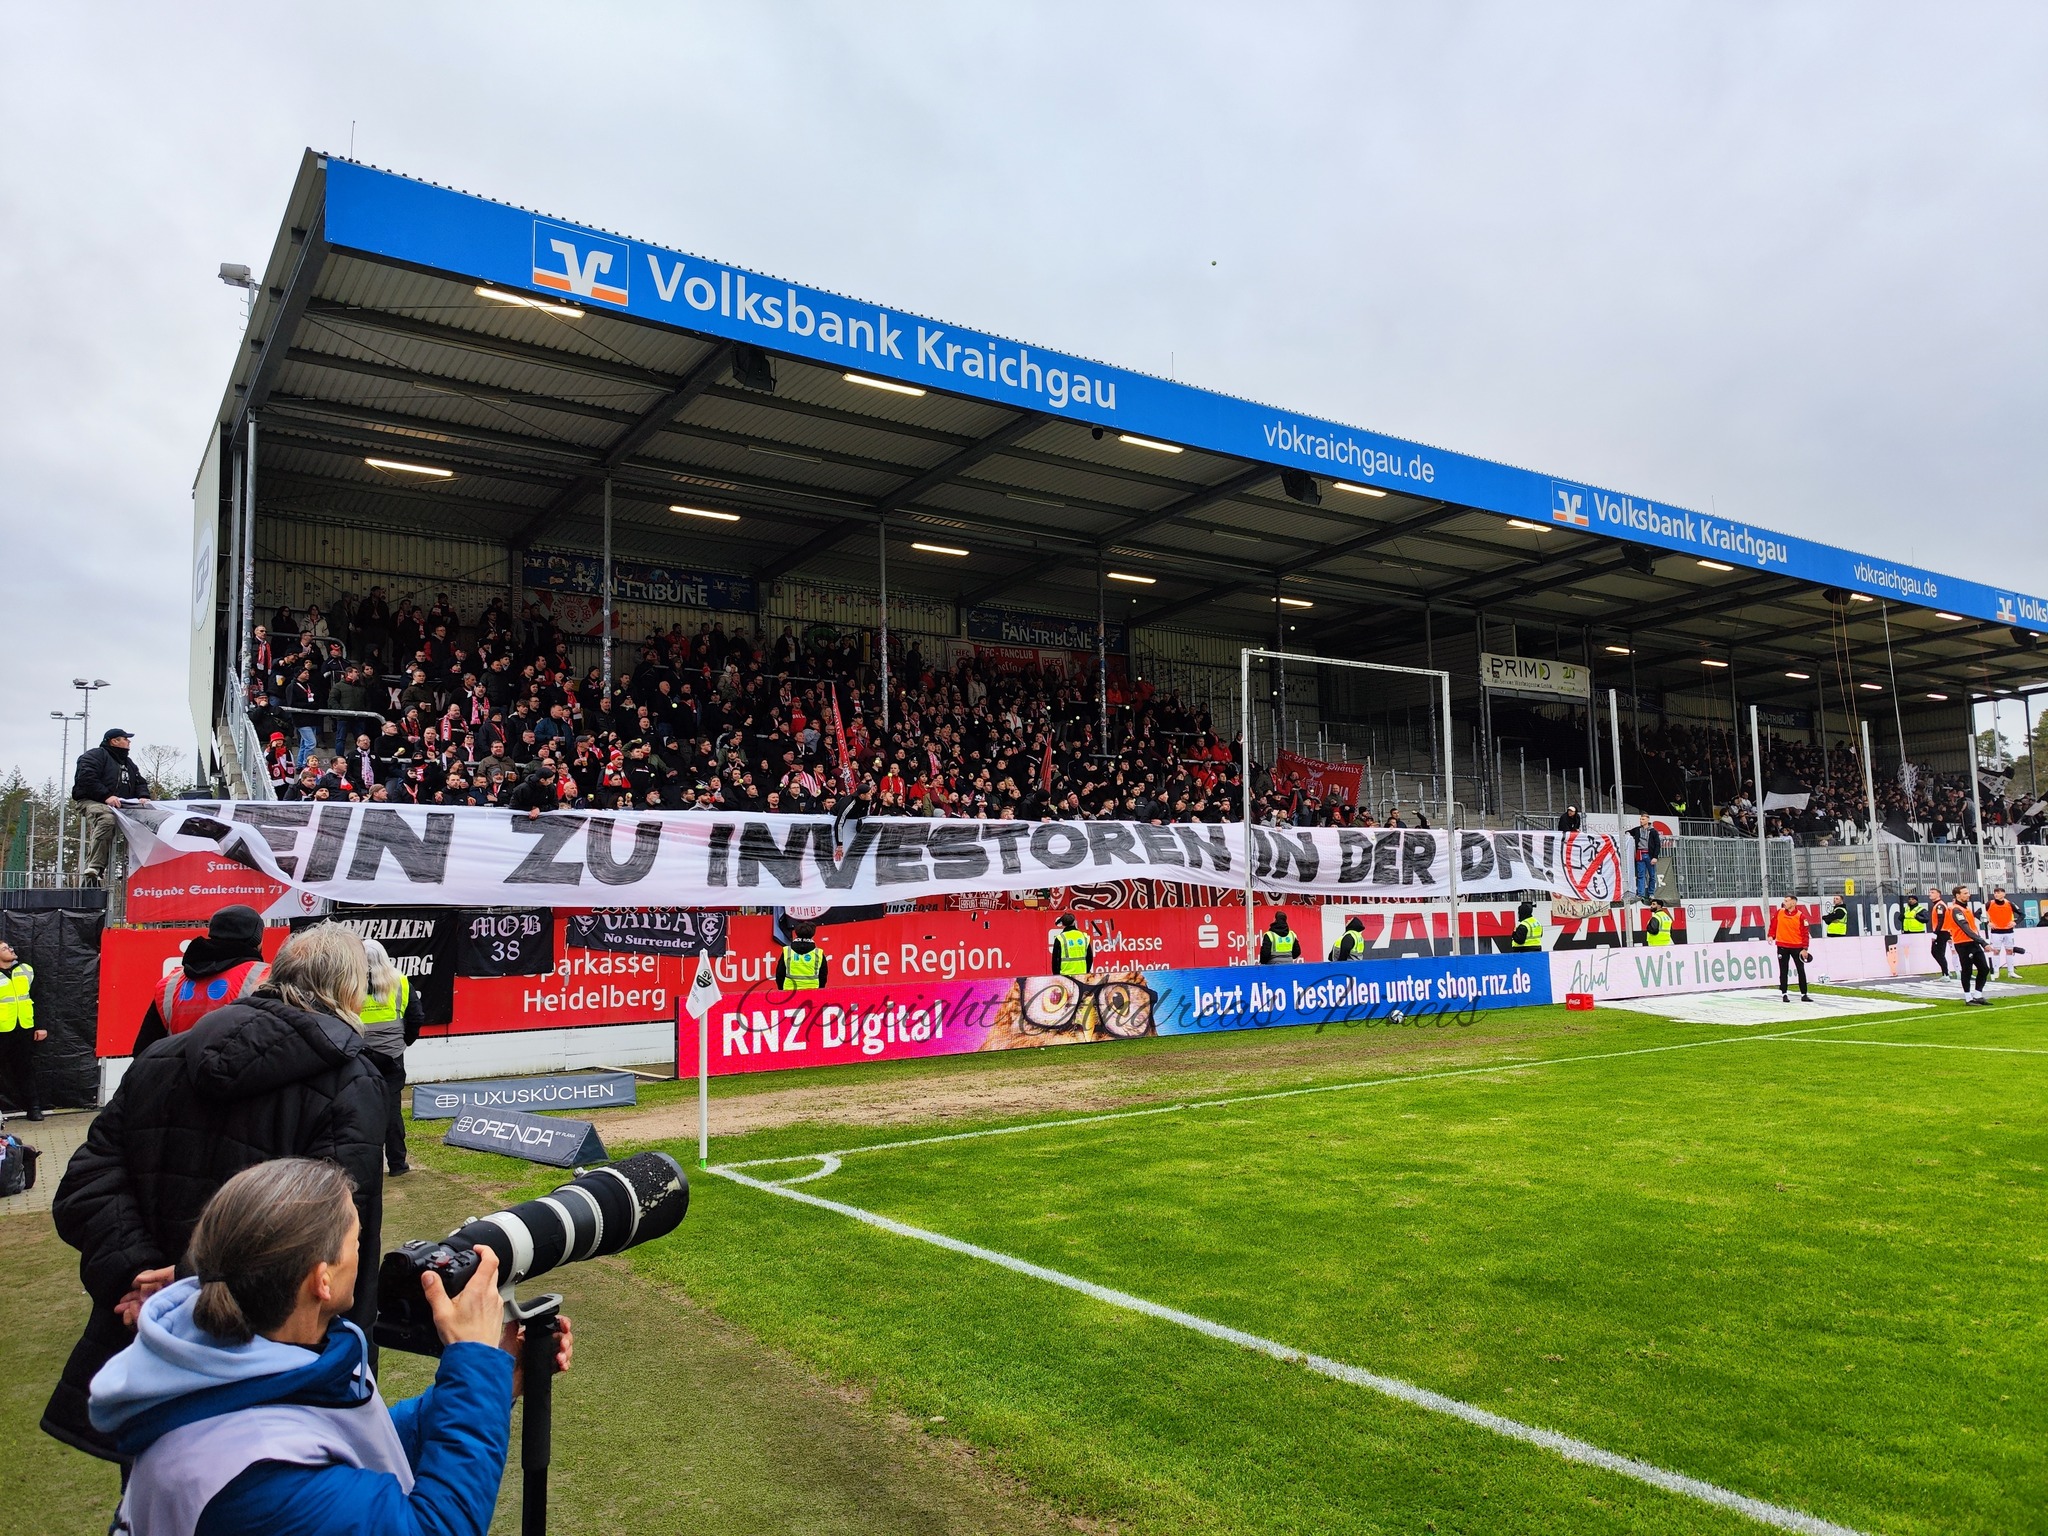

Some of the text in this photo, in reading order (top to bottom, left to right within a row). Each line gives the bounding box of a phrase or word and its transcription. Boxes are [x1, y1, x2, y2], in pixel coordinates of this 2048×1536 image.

[647, 253, 1117, 411] Volksbank Kraichgau
[1263, 421, 1435, 485] vbkraichgau.de
[1593, 491, 1788, 565] Volksbank Kraichgau
[1853, 563, 1938, 599] vbkraichgau.de
[2017, 597, 2048, 623] Volks
[503, 814, 663, 887] ZU
[706, 820, 1233, 889] INVESTOREN
[1252, 827, 1320, 883] IN
[1338, 829, 1438, 885] DER
[132, 883, 284, 899] Brigade Saalesturm 71
[468, 914, 543, 940] MOB
[603, 932, 696, 949] No Surrender
[1092, 931, 1163, 954] parkasse
[491, 939, 521, 962] 38
[842, 943, 889, 978] die
[900, 944, 1011, 981] Region.
[522, 952, 655, 984] arkasse
[1634, 950, 1685, 989] Wir
[1695, 948, 1773, 984] lieben
[523, 984, 666, 1013] Heidelberg
[1192, 967, 1531, 1018] Jetzt Abo bestellen unter shop.rnz.de
[722, 998, 943, 1057] RNZ Digital
[472, 1118, 554, 1148] ORENDA
